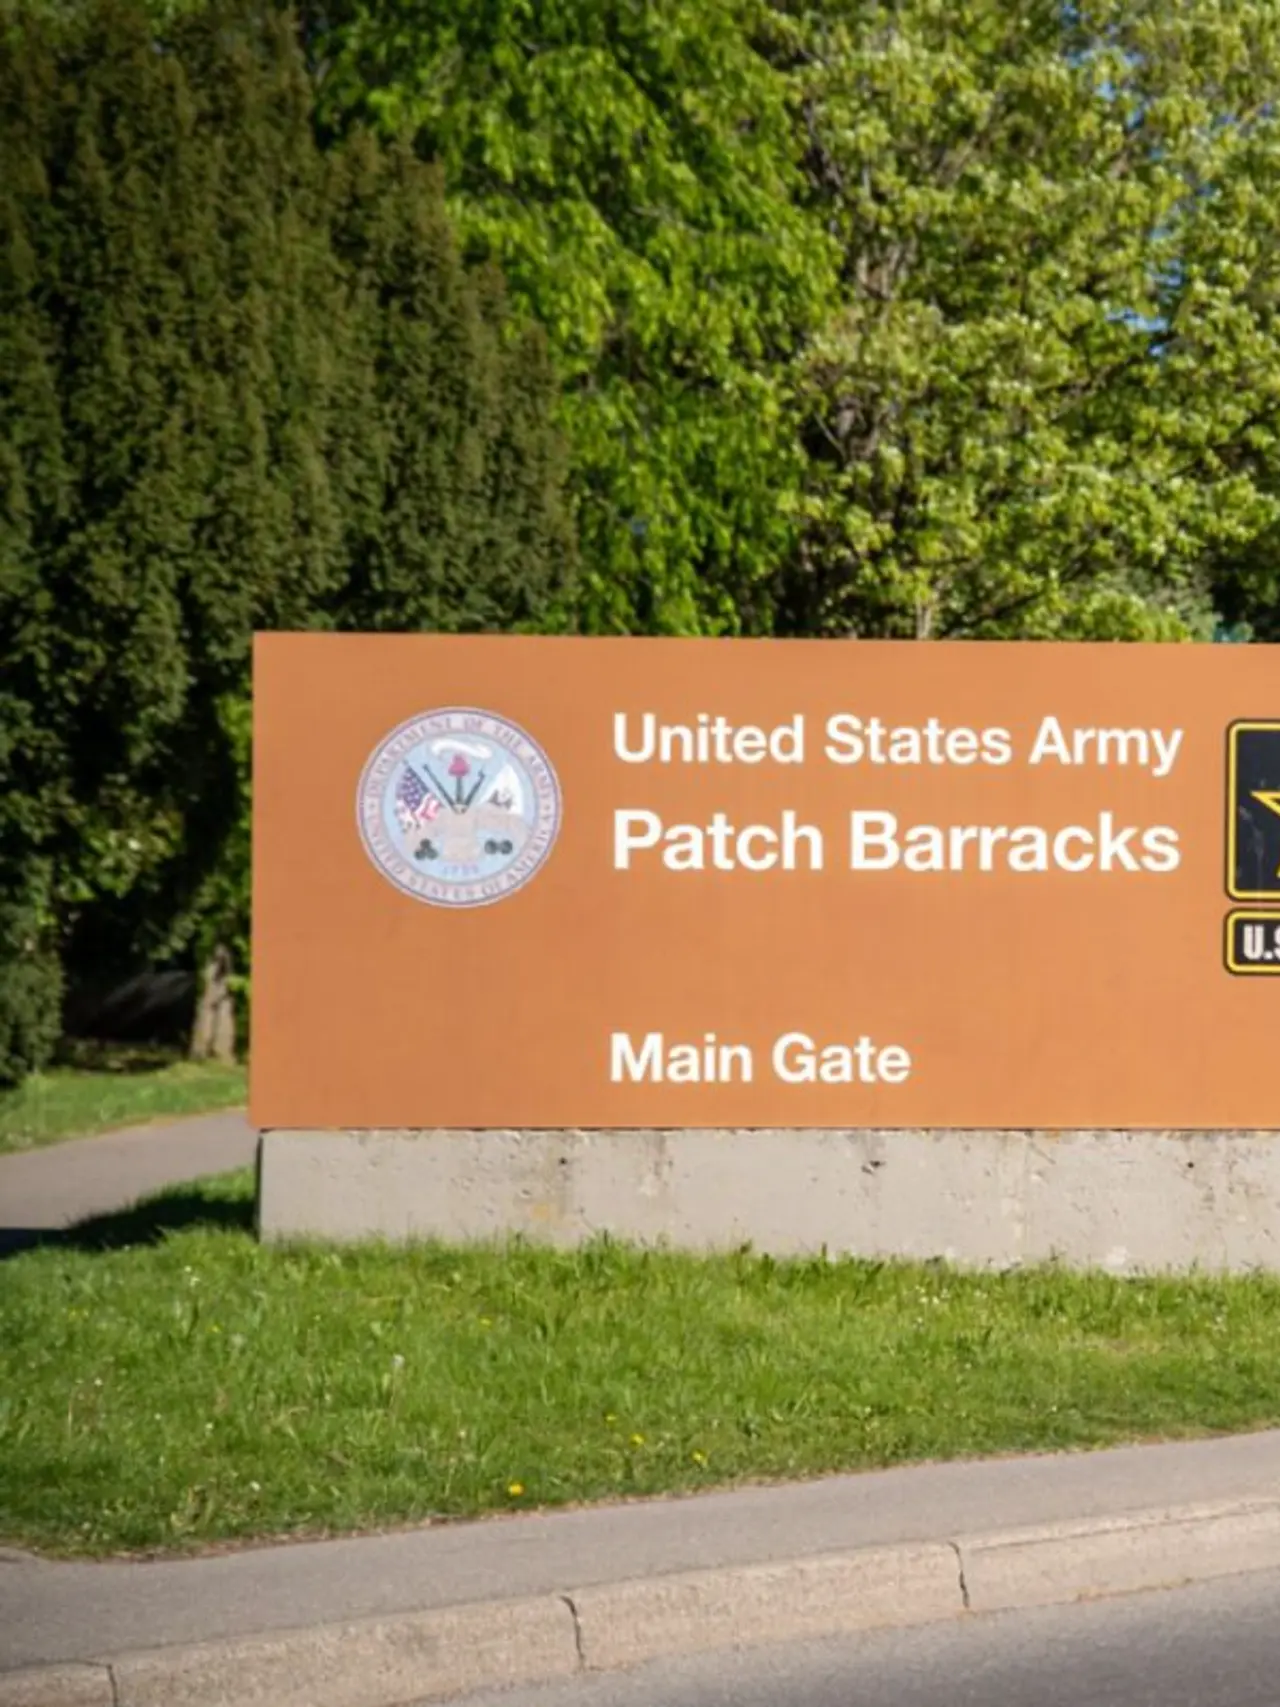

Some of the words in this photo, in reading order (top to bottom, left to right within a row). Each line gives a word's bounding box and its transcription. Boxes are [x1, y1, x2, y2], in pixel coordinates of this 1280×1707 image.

[612, 712, 805, 764] United
[824, 713, 1013, 766] States
[1028, 715, 1184, 777] Army
[613, 809, 824, 871] Patch
[849, 810, 1182, 873] Barracks
[609, 1031, 754, 1084] Main
[771, 1031, 912, 1085] Gate
